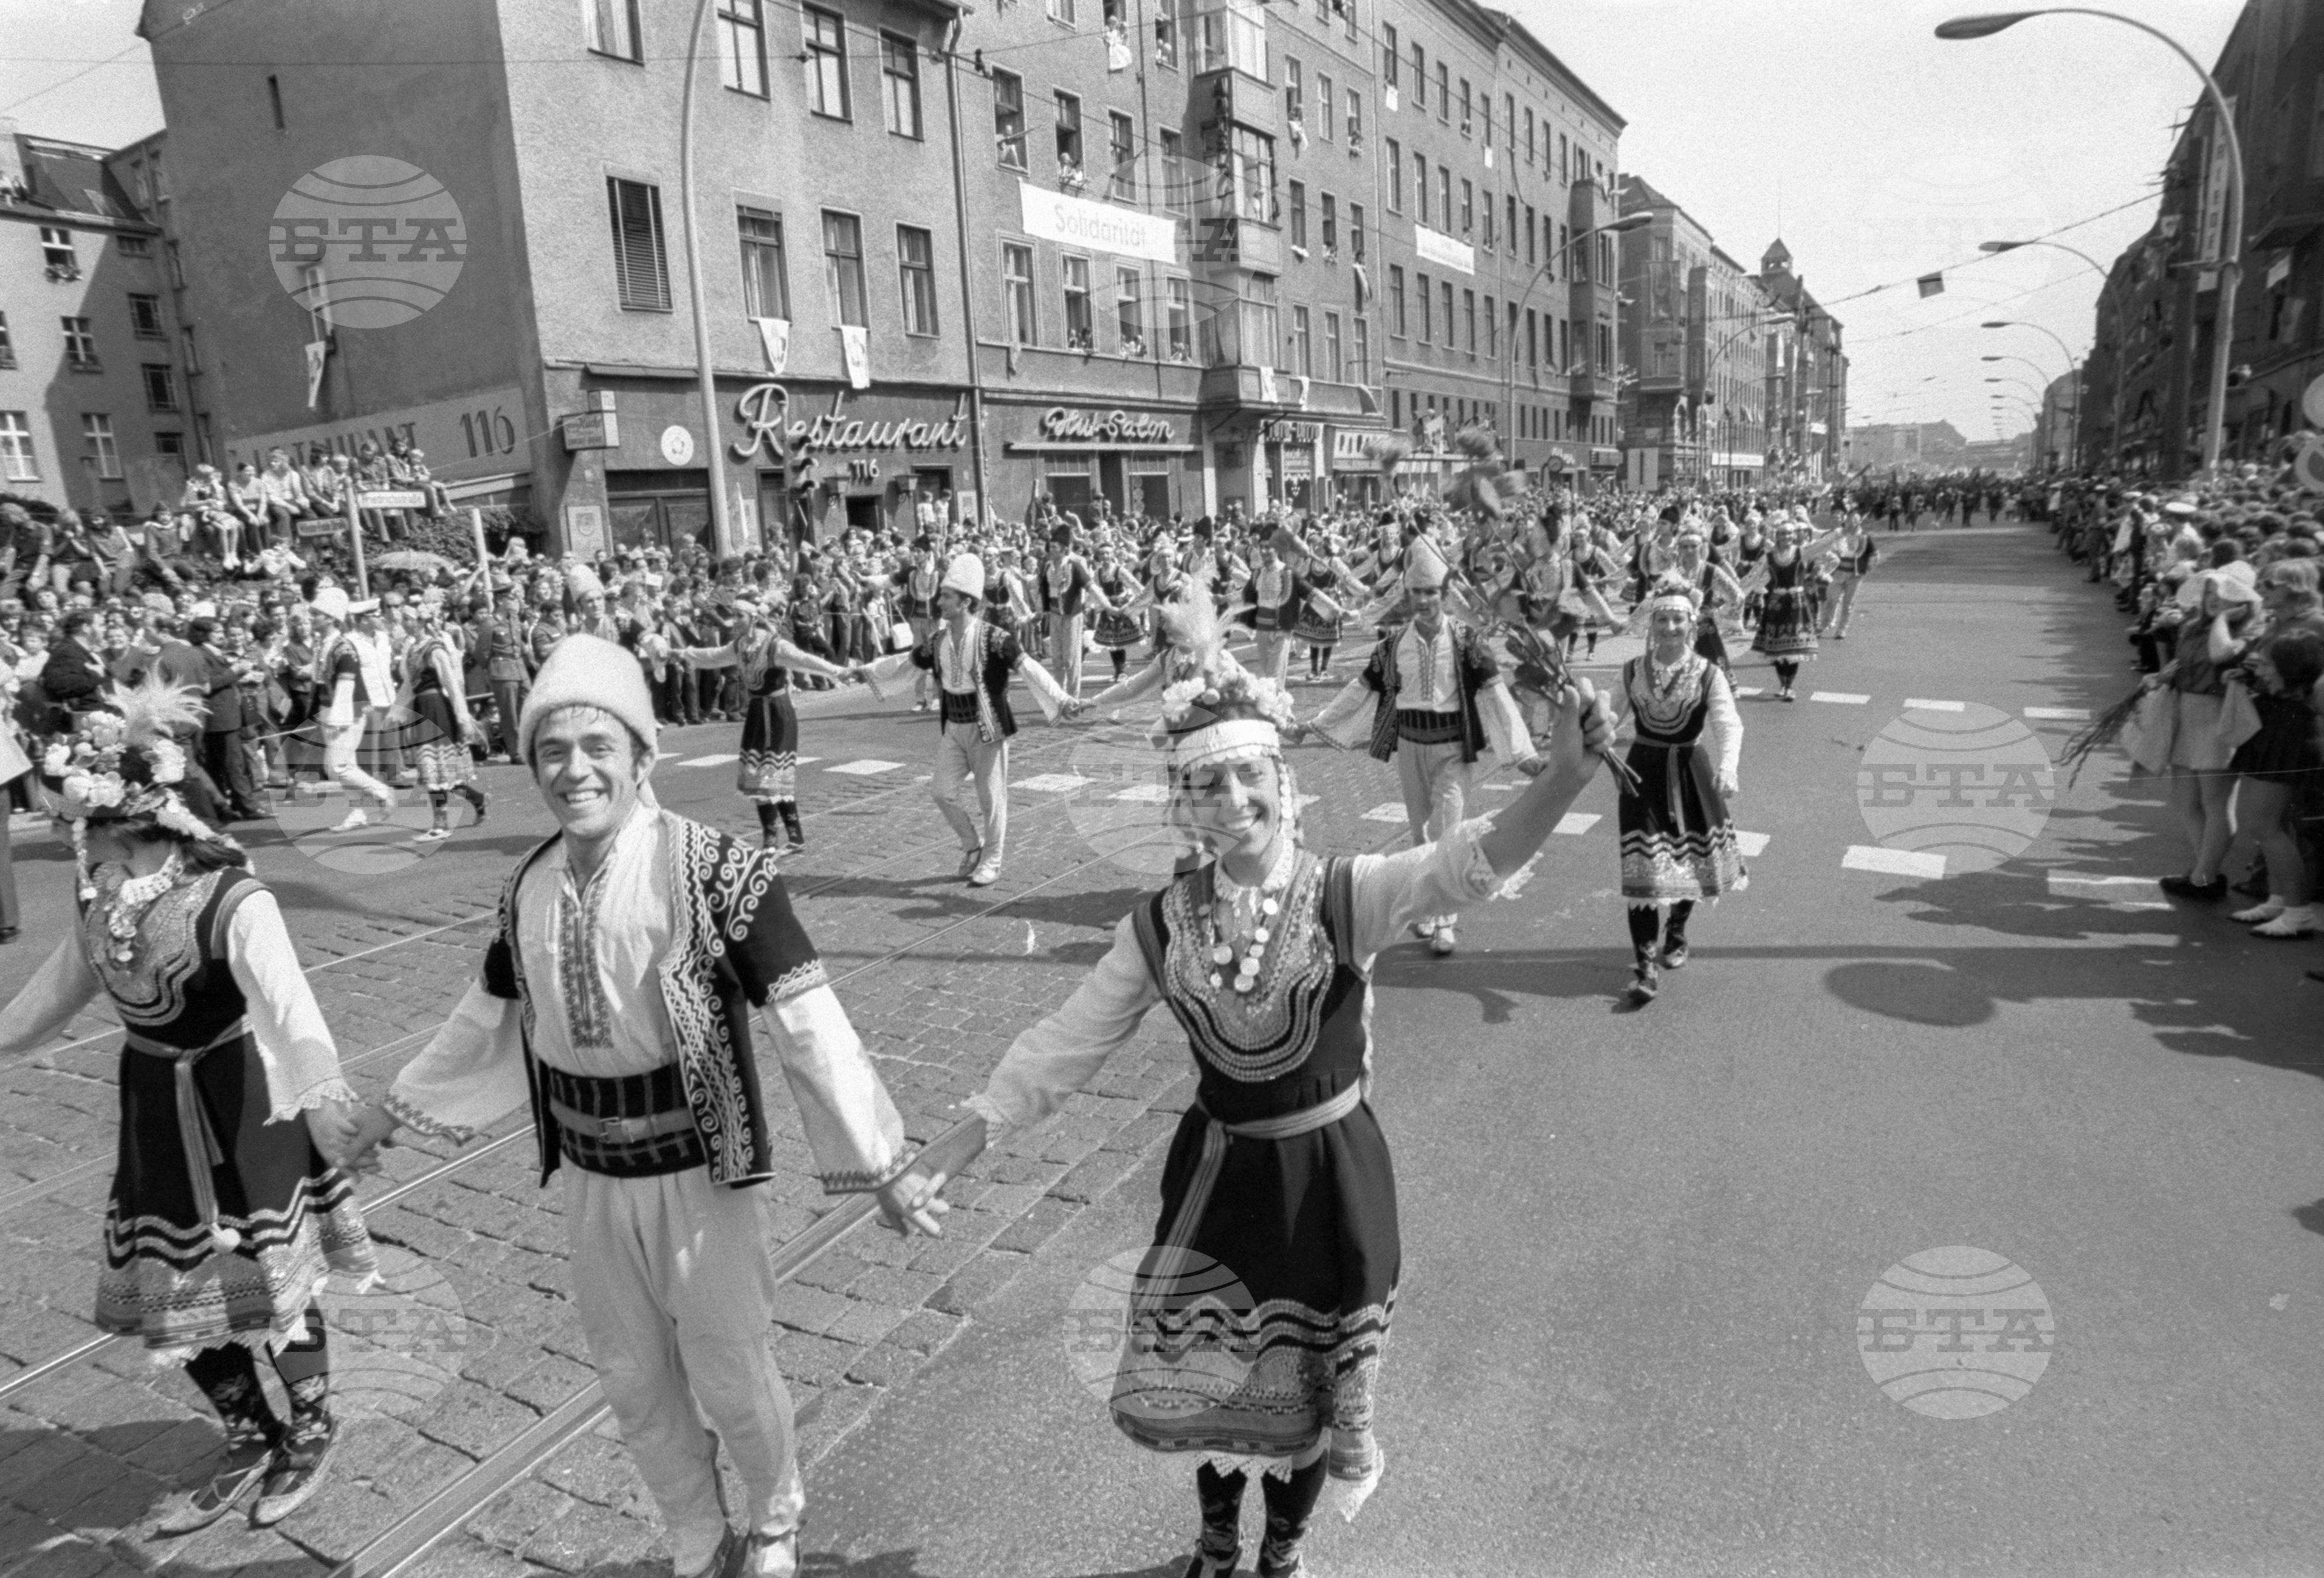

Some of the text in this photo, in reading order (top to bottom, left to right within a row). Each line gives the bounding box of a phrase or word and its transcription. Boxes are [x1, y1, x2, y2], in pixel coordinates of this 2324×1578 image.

[460, 406, 515, 457] 116
[734, 383, 968, 456] Restaurant
[852, 458, 880, 478] 116
